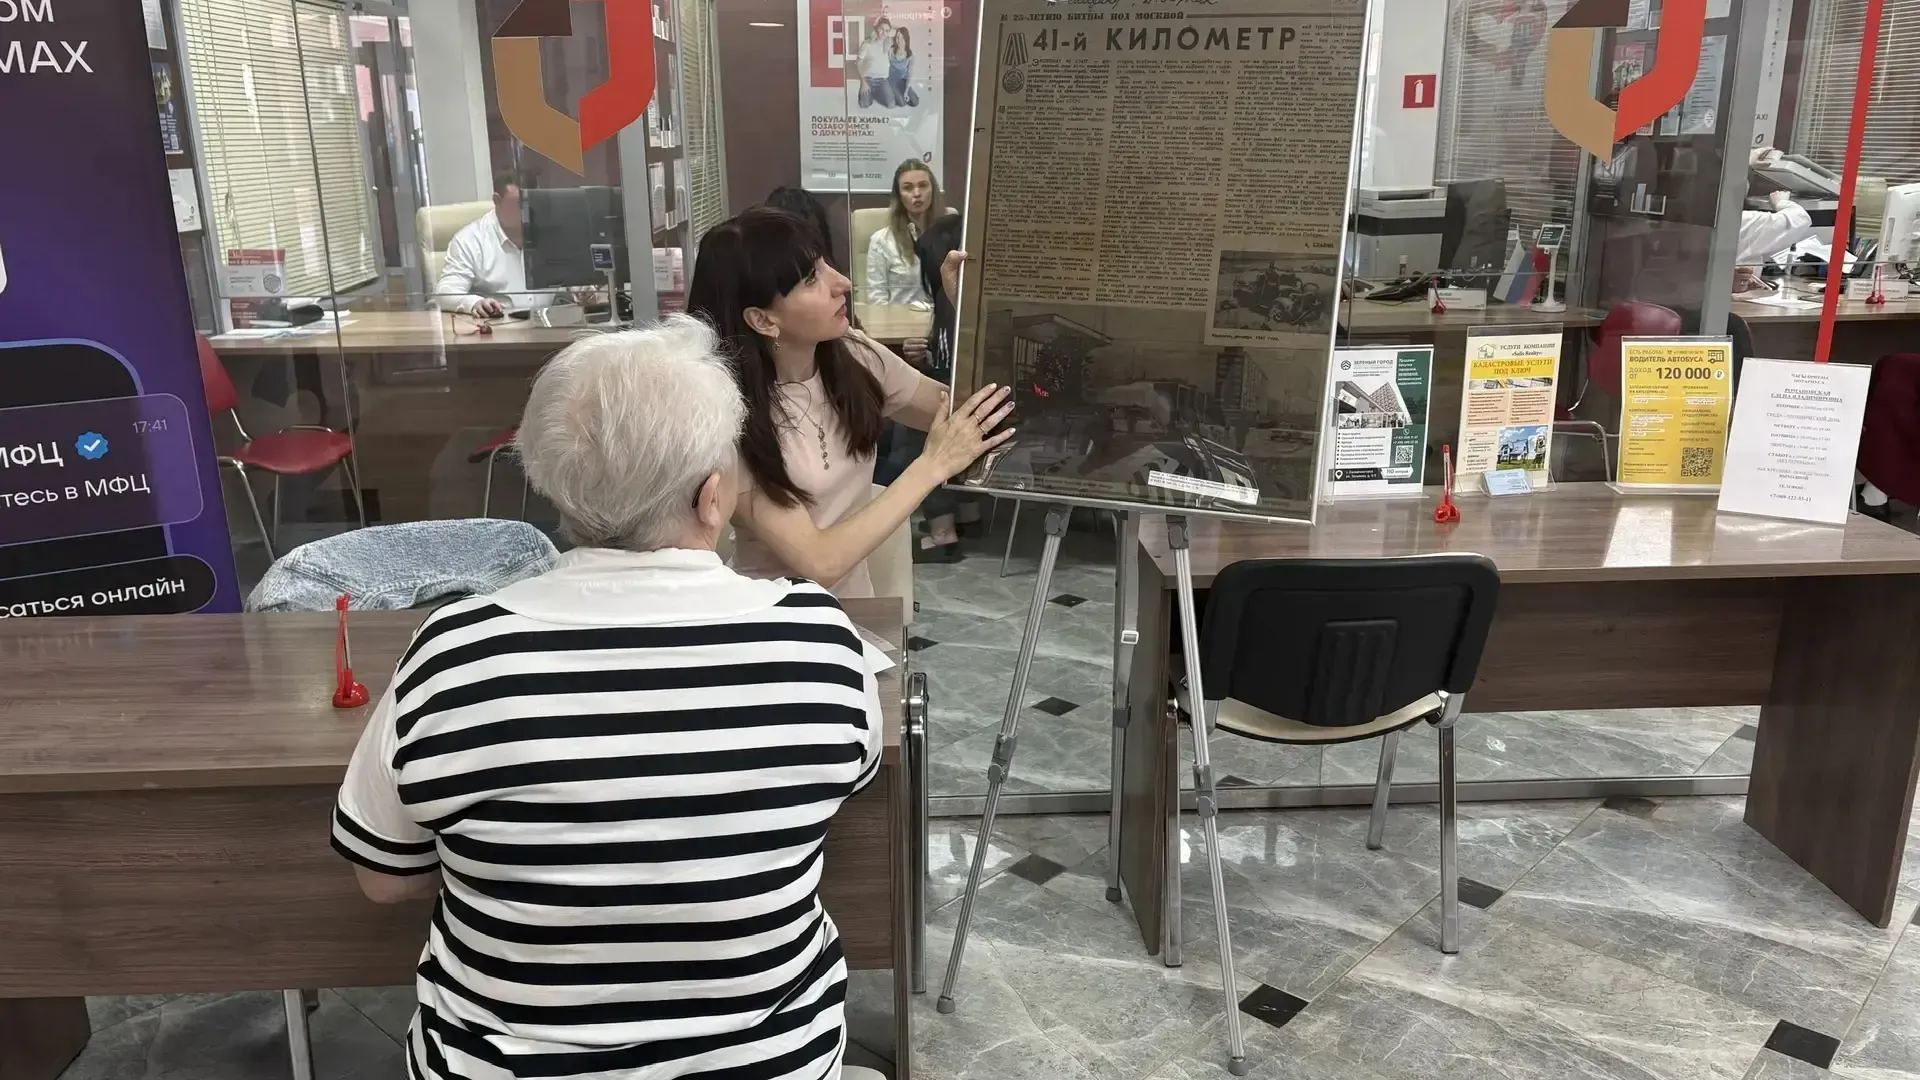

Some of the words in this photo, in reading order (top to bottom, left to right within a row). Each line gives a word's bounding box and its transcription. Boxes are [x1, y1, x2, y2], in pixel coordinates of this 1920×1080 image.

[1012, 13, 1063, 21] 25-ЛЕТИЮ
[1067, 12, 1104, 21] БИТВЫ
[1110, 12, 1131, 21] ПОД
[1135, 11, 1184, 21] МОСКВОЙ
[1033, 28, 1088, 51] 41-й
[1106, 26, 1297, 51] КИЛОМЕТР
[811, 115, 857, 123] ПОКУПАТЕ
[1473, 360, 1525, 369] КАДАСТРОВЫЕ
[1526, 358, 1553, 367] УСЛУГИ
[1493, 368, 1509, 376] ПОД
[1511, 367, 1532, 375] КЛЮЧ
[1656, 367, 1681, 380] 120
[1685, 367, 1711, 380] 000
[132, 419, 168, 434] 17:41
[0, 489, 59, 508] тесь
[65, 486, 79, 500] в
[84, 473, 151, 498] МФЦ
[0, 595, 85, 619] саться
[91, 577, 186, 606] онлайн
